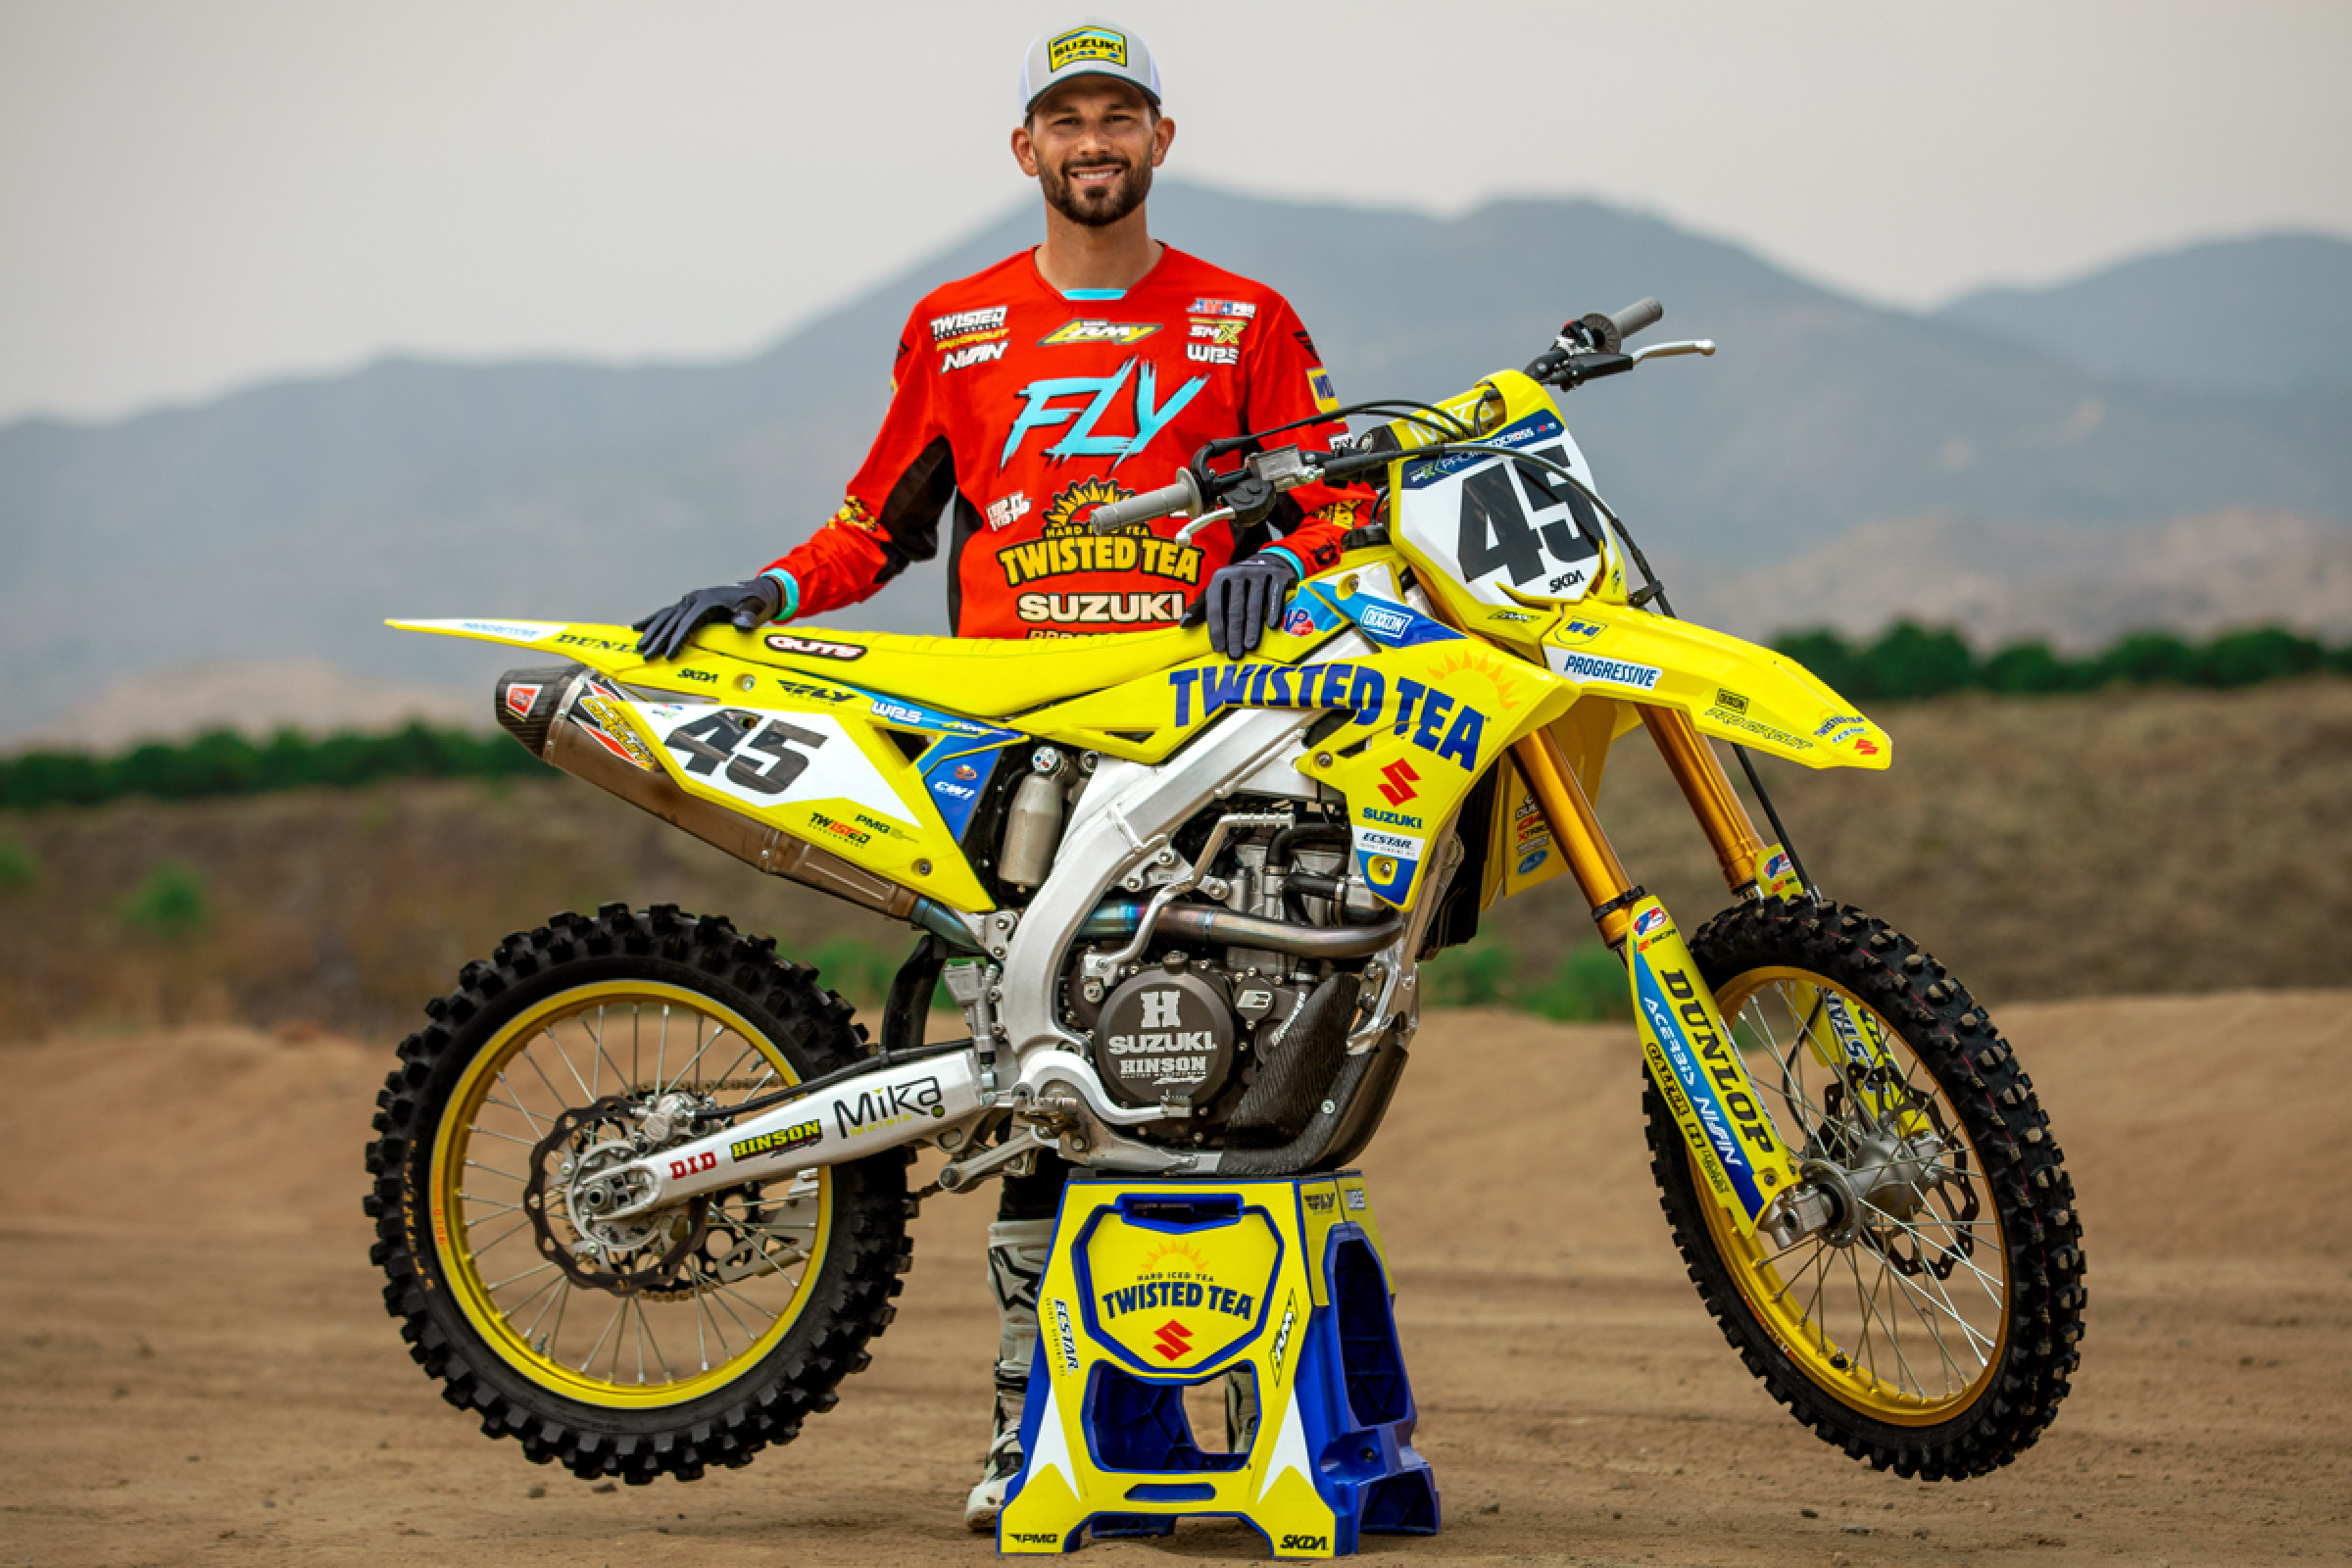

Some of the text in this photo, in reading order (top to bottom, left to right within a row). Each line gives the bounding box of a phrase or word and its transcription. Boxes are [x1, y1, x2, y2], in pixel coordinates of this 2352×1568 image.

[1054, 38, 1122, 57] SUZUKI
[1186, 343, 1240, 366] WPS
[997, 352, 1211, 477] FLY
[1457, 444, 1605, 587] 45
[998, 536, 1203, 586] TWISTED TEA
[1017, 592, 1185, 623] SUZUKI
[1564, 655, 1658, 688] PROGRESSIVE
[1168, 662, 1487, 773] TWISTED TEA
[663, 708, 830, 795] 45
[808, 812, 872, 844] TWISTED
[1362, 807, 1423, 830] SUZUKI
[1361, 832, 1412, 850] ECSTAR
[1108, 1031, 1215, 1054] SUZUKI
[1119, 1055, 1206, 1074] HINSON
[1659, 968, 1775, 1154] DUNLOP
[833, 1076, 943, 1139] Mika
[731, 1119, 821, 1159] HINSON
[1102, 1281, 1255, 1322] TWISTED TEA
[1052, 1297, 1080, 1372] ECSTAR
[1021, 1534, 1057, 1544] PMG
[1280, 1534, 1328, 1551] SKDA
